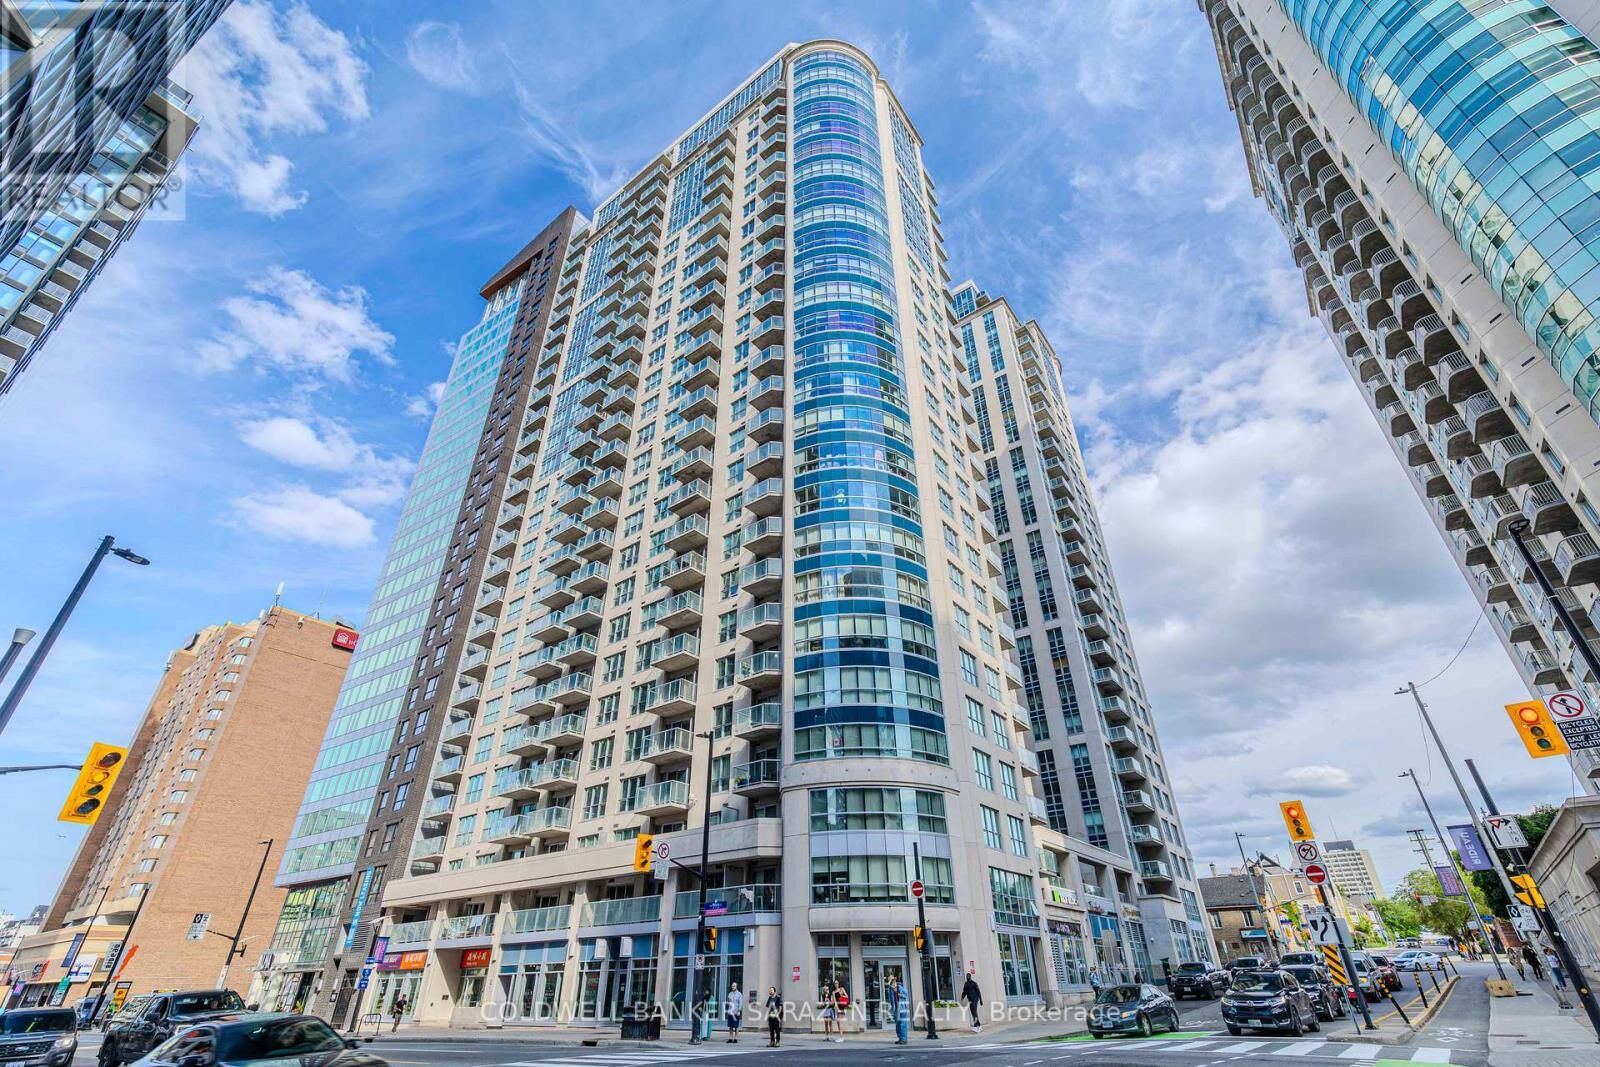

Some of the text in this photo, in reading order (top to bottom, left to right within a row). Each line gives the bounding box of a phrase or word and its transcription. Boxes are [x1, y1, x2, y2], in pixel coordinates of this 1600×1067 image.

[1560, 719, 1595, 729] BICYCLES
[1563, 725, 1598, 734] EXCEPTED
[1567, 735, 1585, 743] SAUF
[1570, 738, 1600, 749] BICYCLETT
